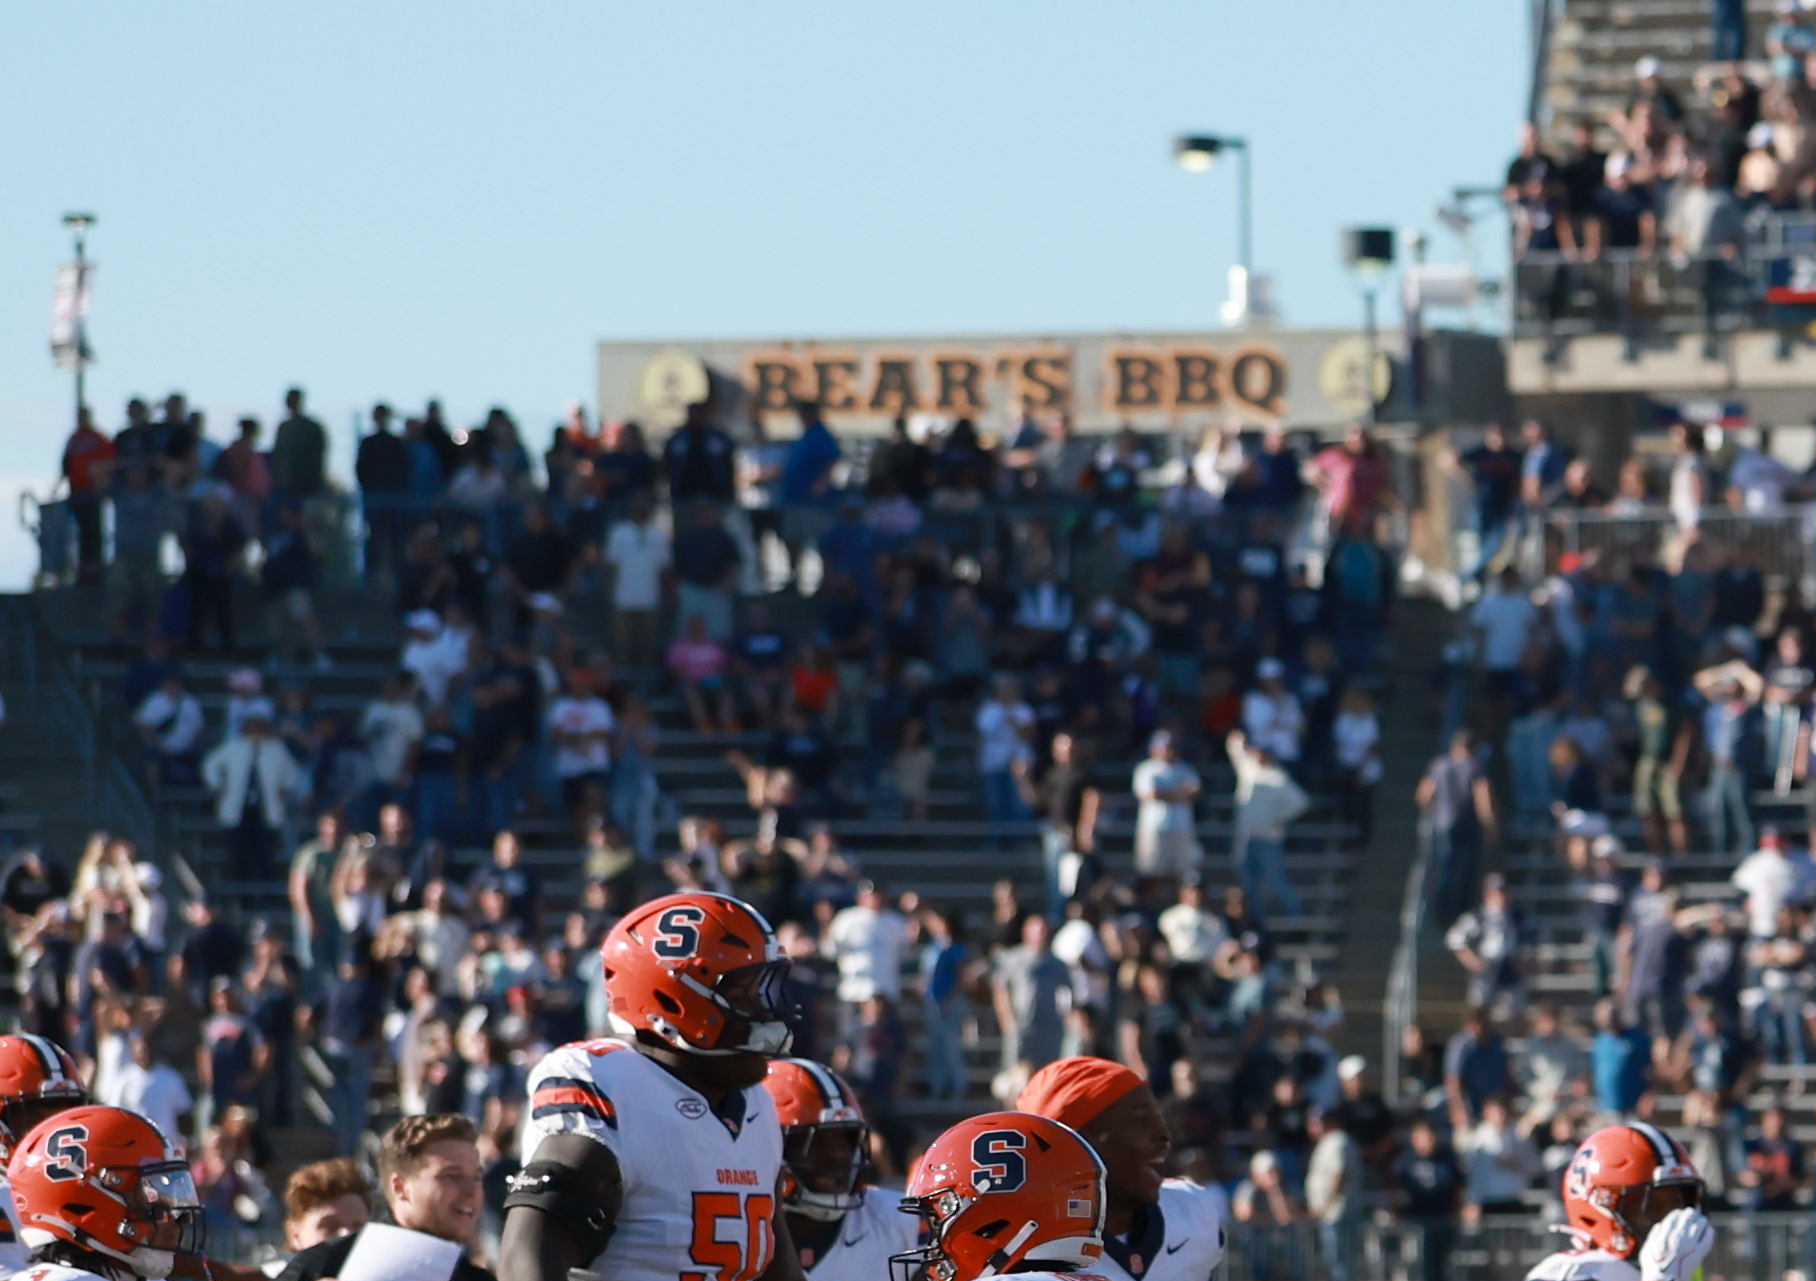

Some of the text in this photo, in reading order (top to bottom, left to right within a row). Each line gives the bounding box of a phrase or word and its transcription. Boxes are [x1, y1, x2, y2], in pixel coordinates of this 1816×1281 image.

[751, 351, 1288, 415] BEAR'S BBQ
[653, 906, 706, 960] S
[44, 1124, 90, 1182] S
[716, 1169, 760, 1186] ORANGE
[970, 1129, 1027, 1194] S
